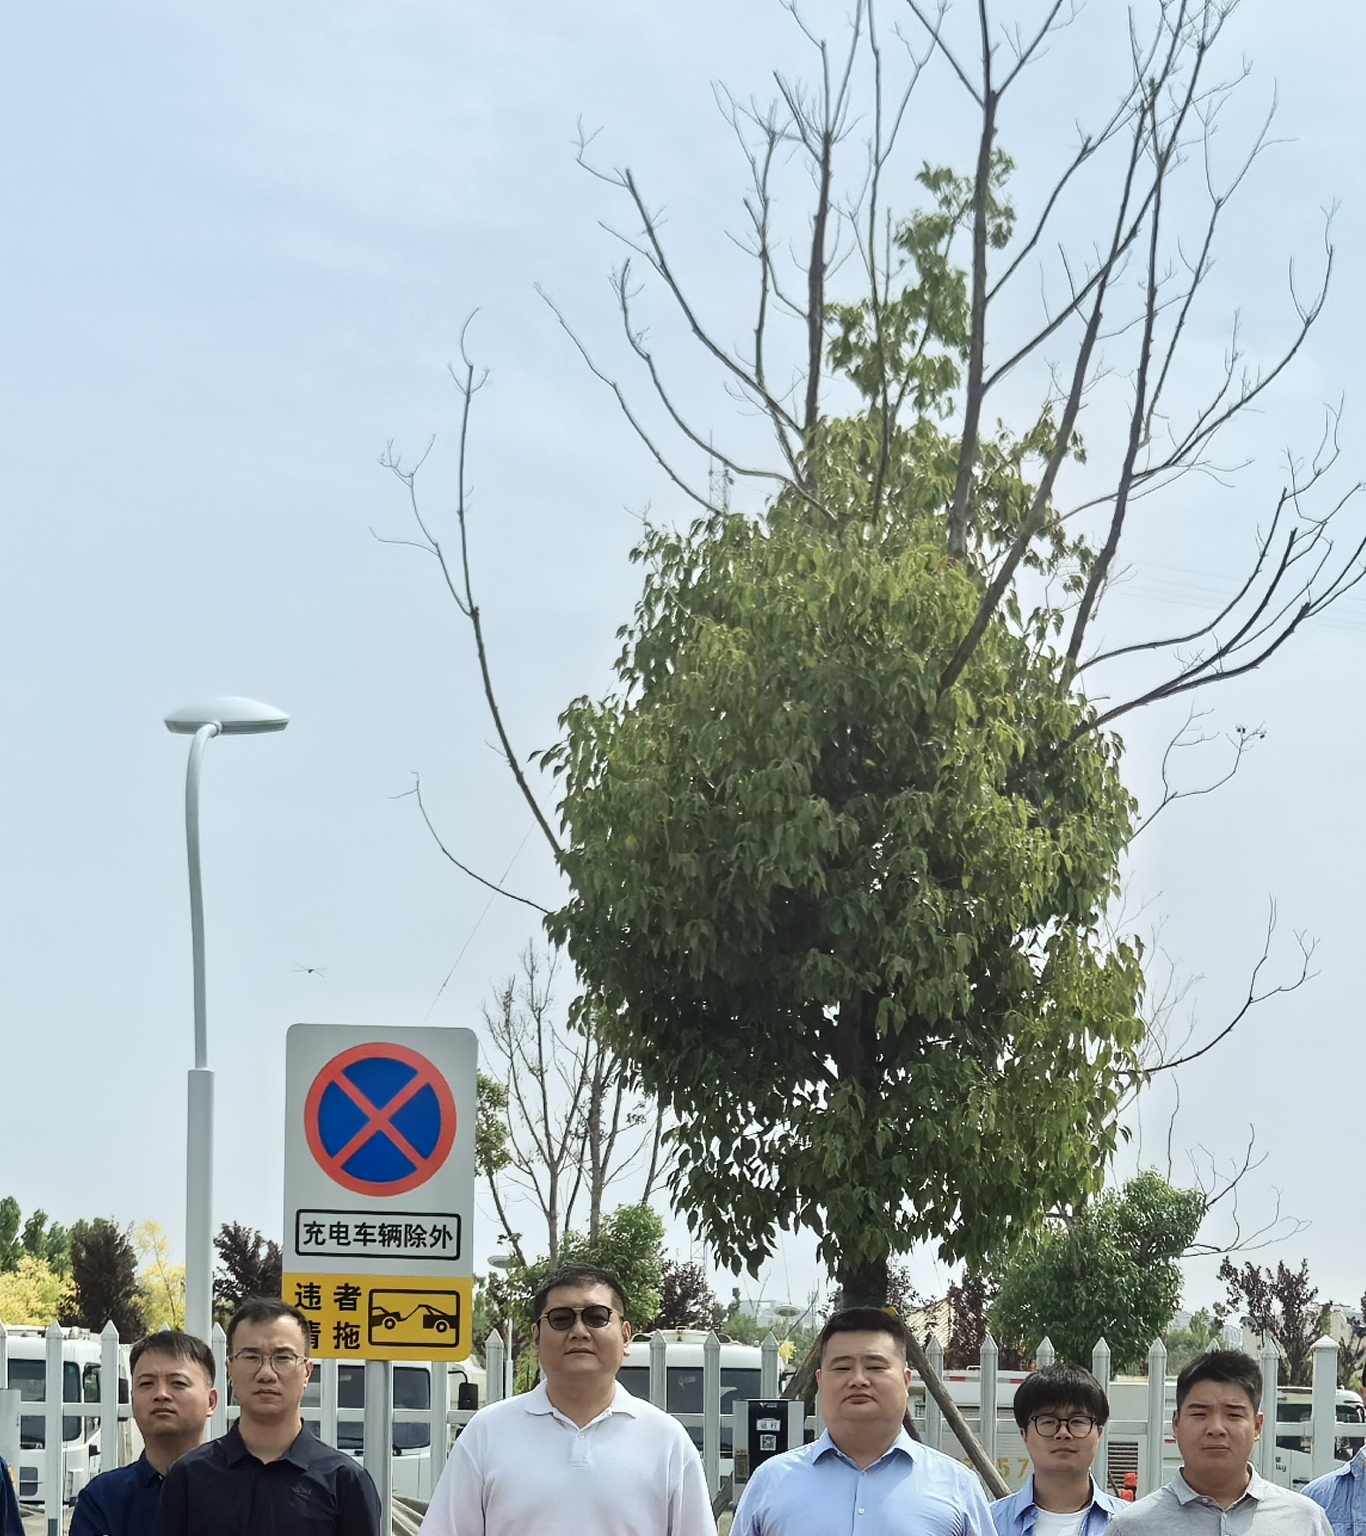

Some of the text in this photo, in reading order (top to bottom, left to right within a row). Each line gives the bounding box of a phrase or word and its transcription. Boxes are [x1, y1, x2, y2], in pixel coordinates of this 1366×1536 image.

[303, 1221, 453, 1249] 充电车辆除外
[295, 1282, 361, 1312] 违者
